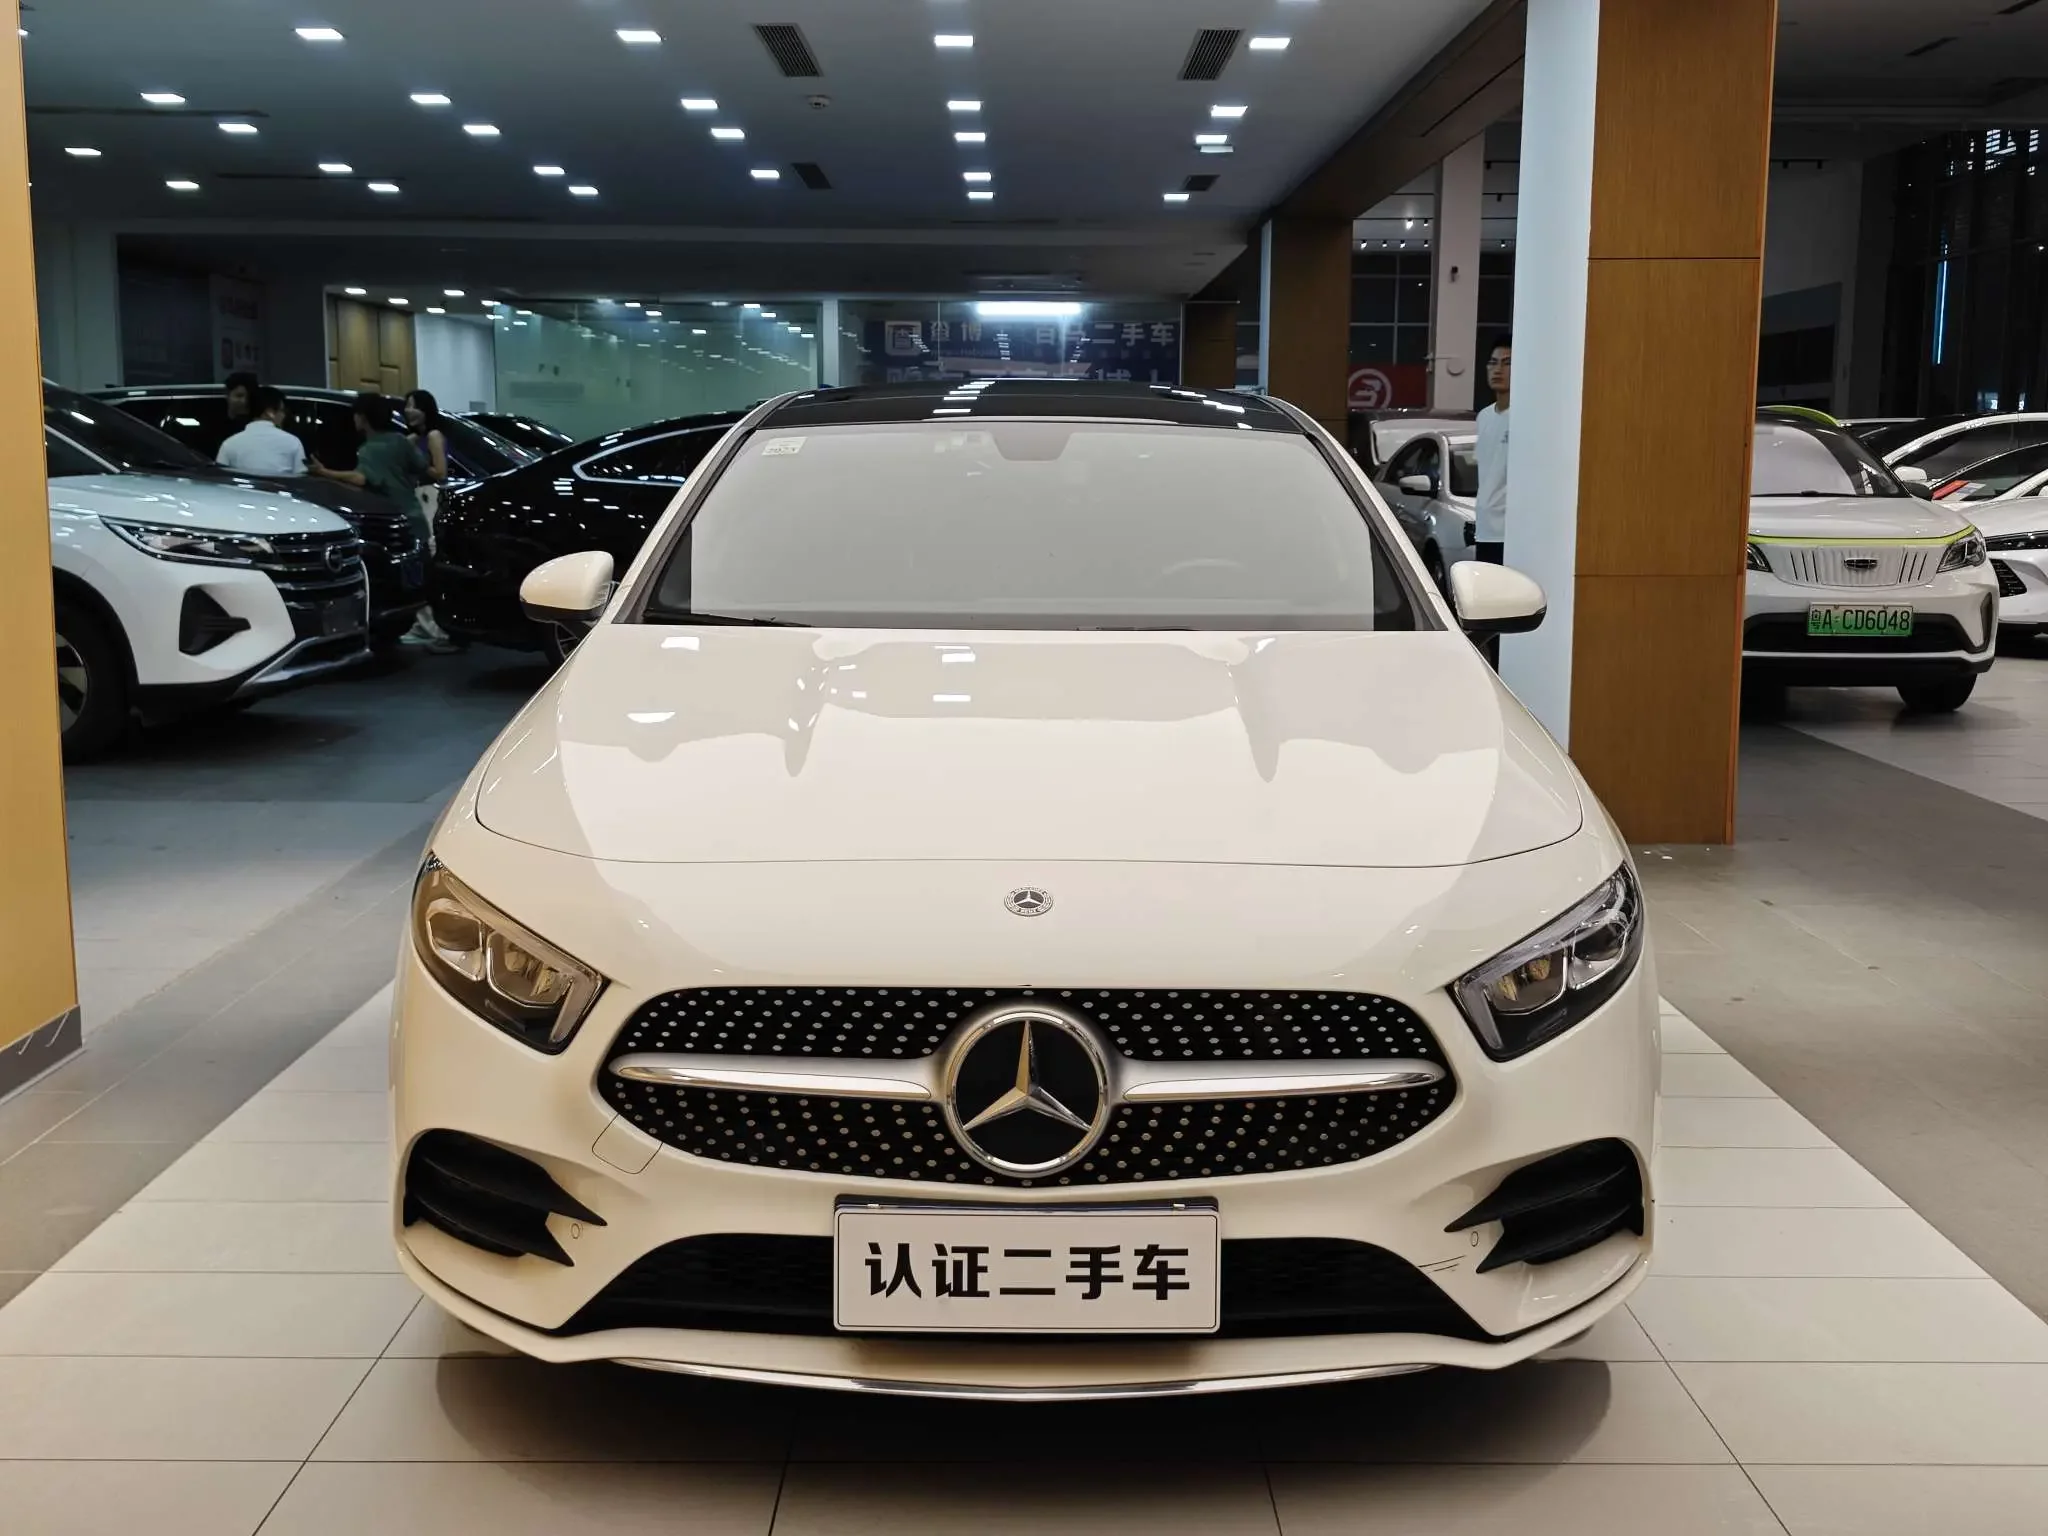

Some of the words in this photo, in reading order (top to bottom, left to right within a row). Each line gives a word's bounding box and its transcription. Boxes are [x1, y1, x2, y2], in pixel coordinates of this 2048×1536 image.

[865, 1242, 1190, 1300] 认证二手车
